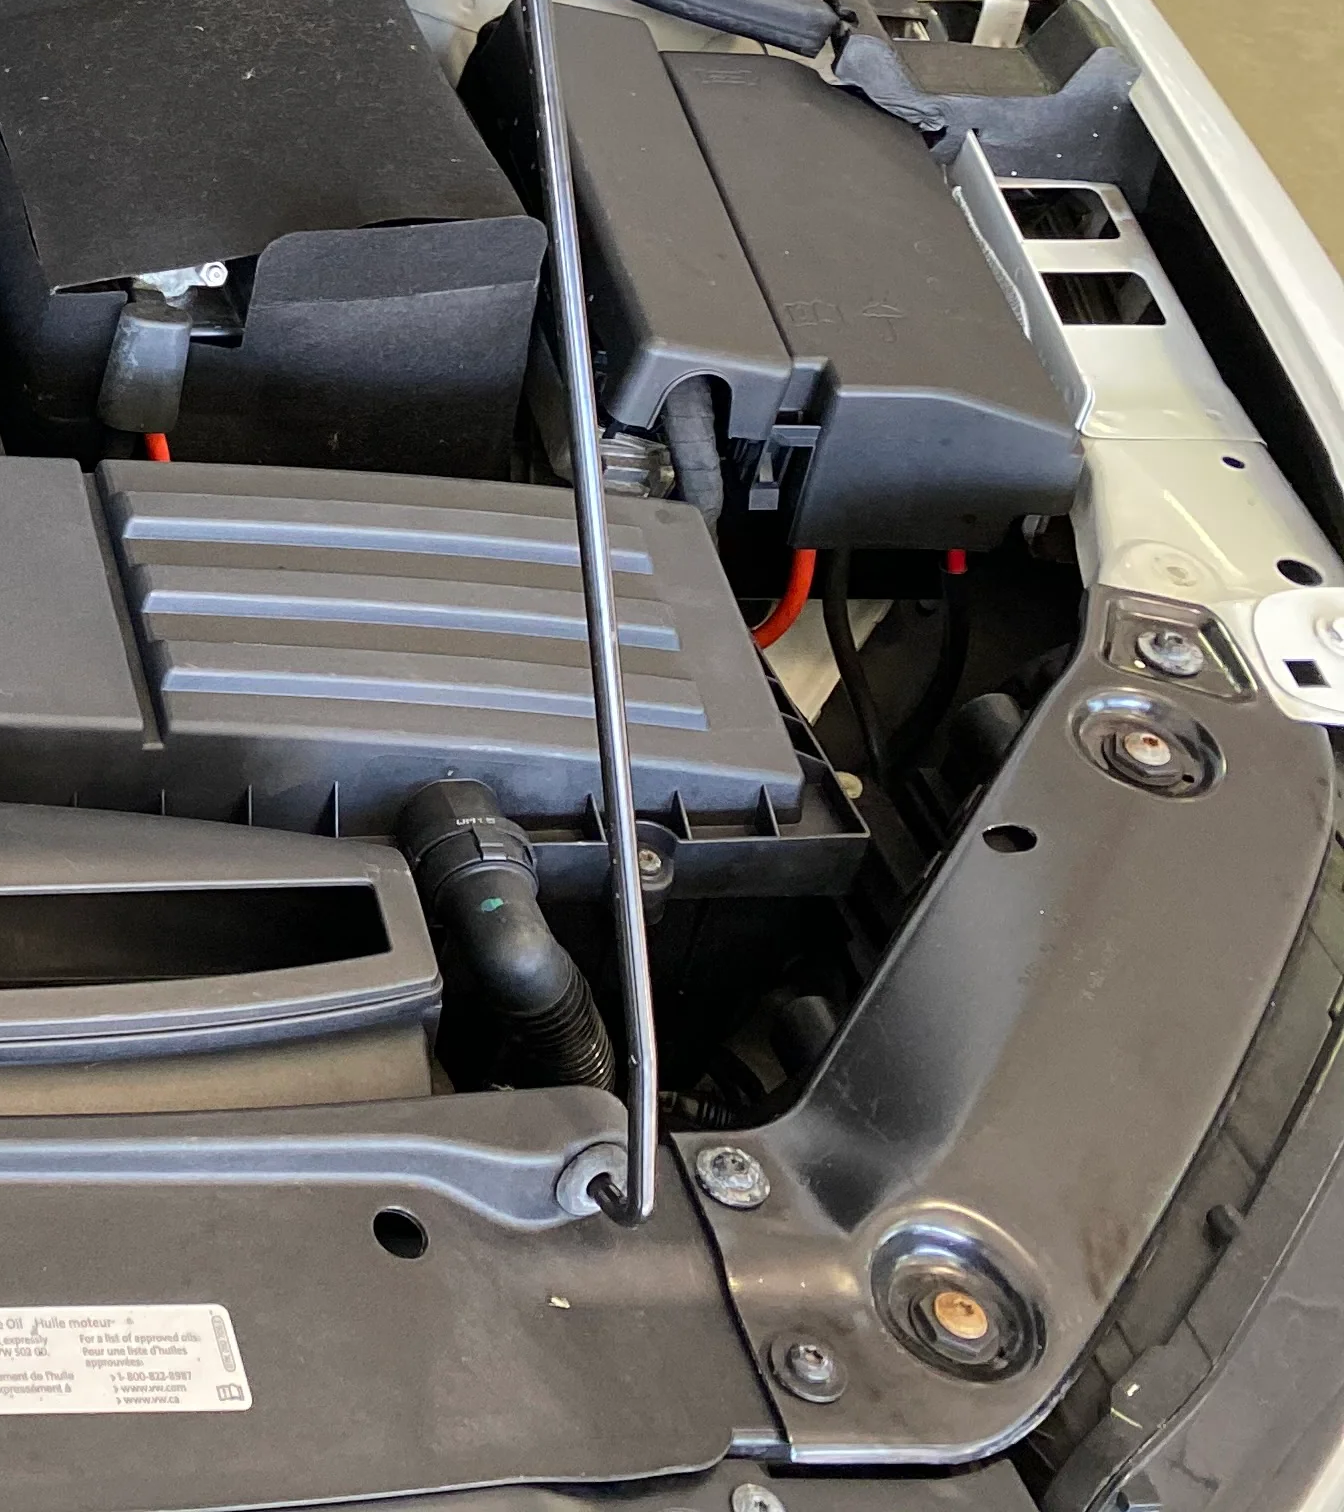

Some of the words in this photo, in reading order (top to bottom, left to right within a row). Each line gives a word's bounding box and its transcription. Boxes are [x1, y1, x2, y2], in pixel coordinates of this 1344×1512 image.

[6, 1318, 24, 1330] Oil
[35, 1317, 66, 1329] Huile
[69, 1318, 111, 1329] moteur
[3, 1335, 47, 1348] expressly
[79, 1334, 96, 1343] For
[105, 1334, 120, 1343] list
[122, 1334, 133, 1343] of
[134, 1333, 179, 1344] approved
[15, 1348, 31, 1357] 502
[82, 1347, 104, 1356] Pour
[107, 1347, 125, 1356] une
[127, 1347, 147, 1356] liste
[150, 1347, 187, 1356] d'huiles
[30, 1372, 43, 1382] de
[123, 1396, 180, 1404] www.vw.ca
